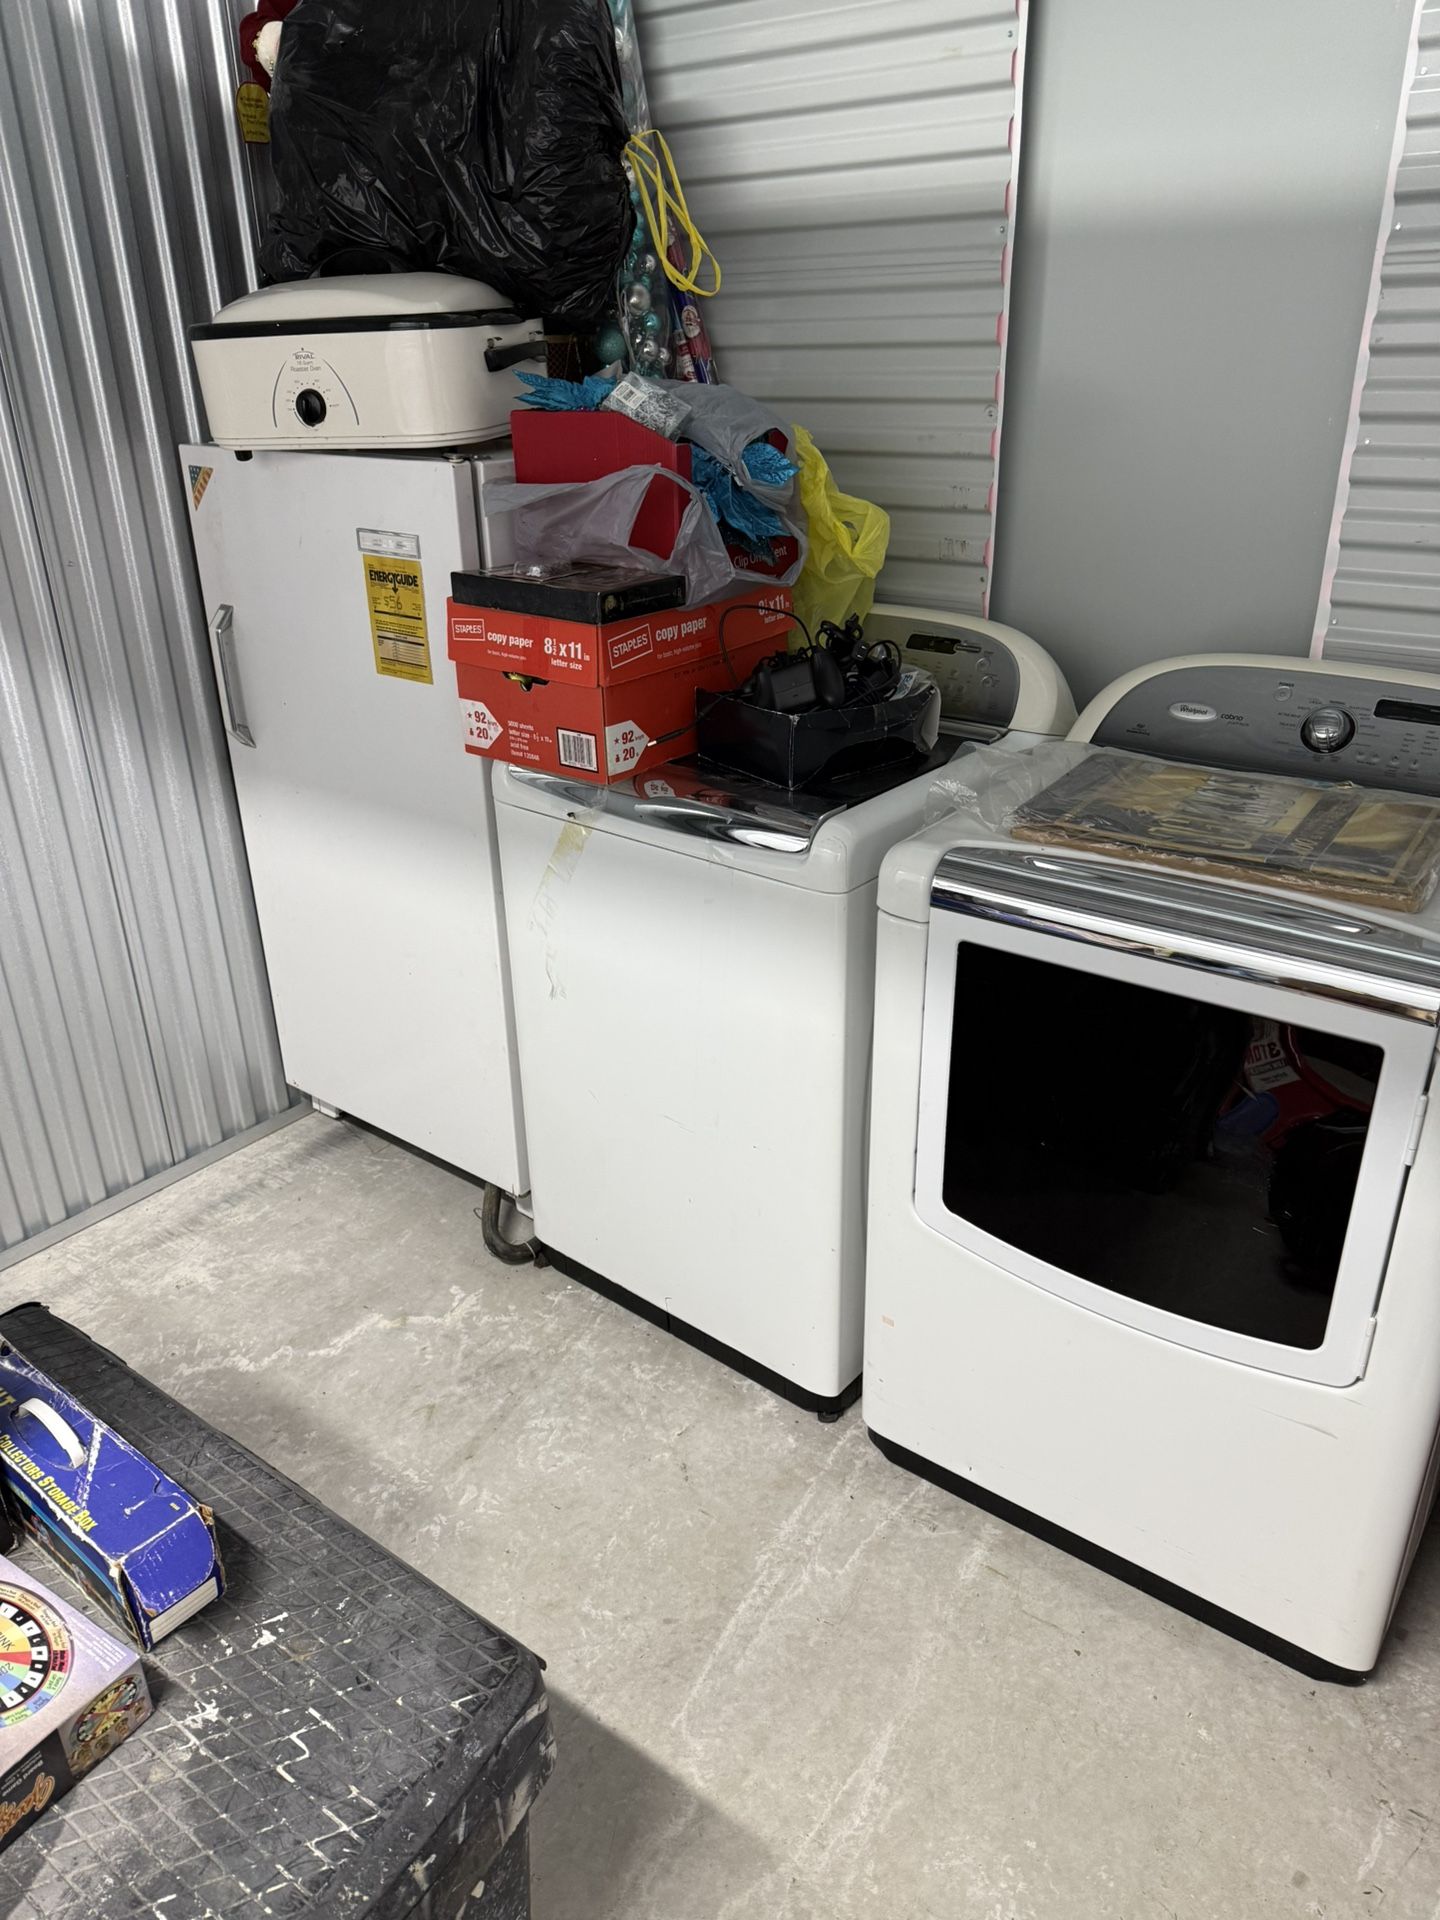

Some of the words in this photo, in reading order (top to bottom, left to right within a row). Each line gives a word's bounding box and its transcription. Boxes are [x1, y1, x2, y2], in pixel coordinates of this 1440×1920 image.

[734, 555, 749, 569] Clip
[749, 545, 788, 564] Ornent
[368, 569, 419, 588] ENERGYGUIDE
[383, 595, 403, 612] $56
[454, 624, 483, 634] STAPLES
[487, 631, 507, 647] copy
[509, 636, 534, 649] paper
[583, 652, 591, 661] in
[612, 633, 649, 658] STAPLES
[655, 625, 679, 642] copy
[681, 616, 708, 637] paper
[551, 657, 568, 669] letter
[569, 660, 583, 671] size
[474, 710, 487, 725] 92
[1180, 705, 1208, 715] Whirlpool
[476, 726, 489, 740] 20
[508, 729, 521, 738] letter
[521, 732, 530, 740] size
[621, 730, 635, 745] 92
[622, 746, 636, 762] 20
[0, 1434, 45, 1481] COLLECTORS
[37, 1475, 78, 1519] STORAGE
[72, 1509, 99, 1532] BOX
[22, 1759, 44, 1781] Board
[1, 1777, 23, 1797] Game
